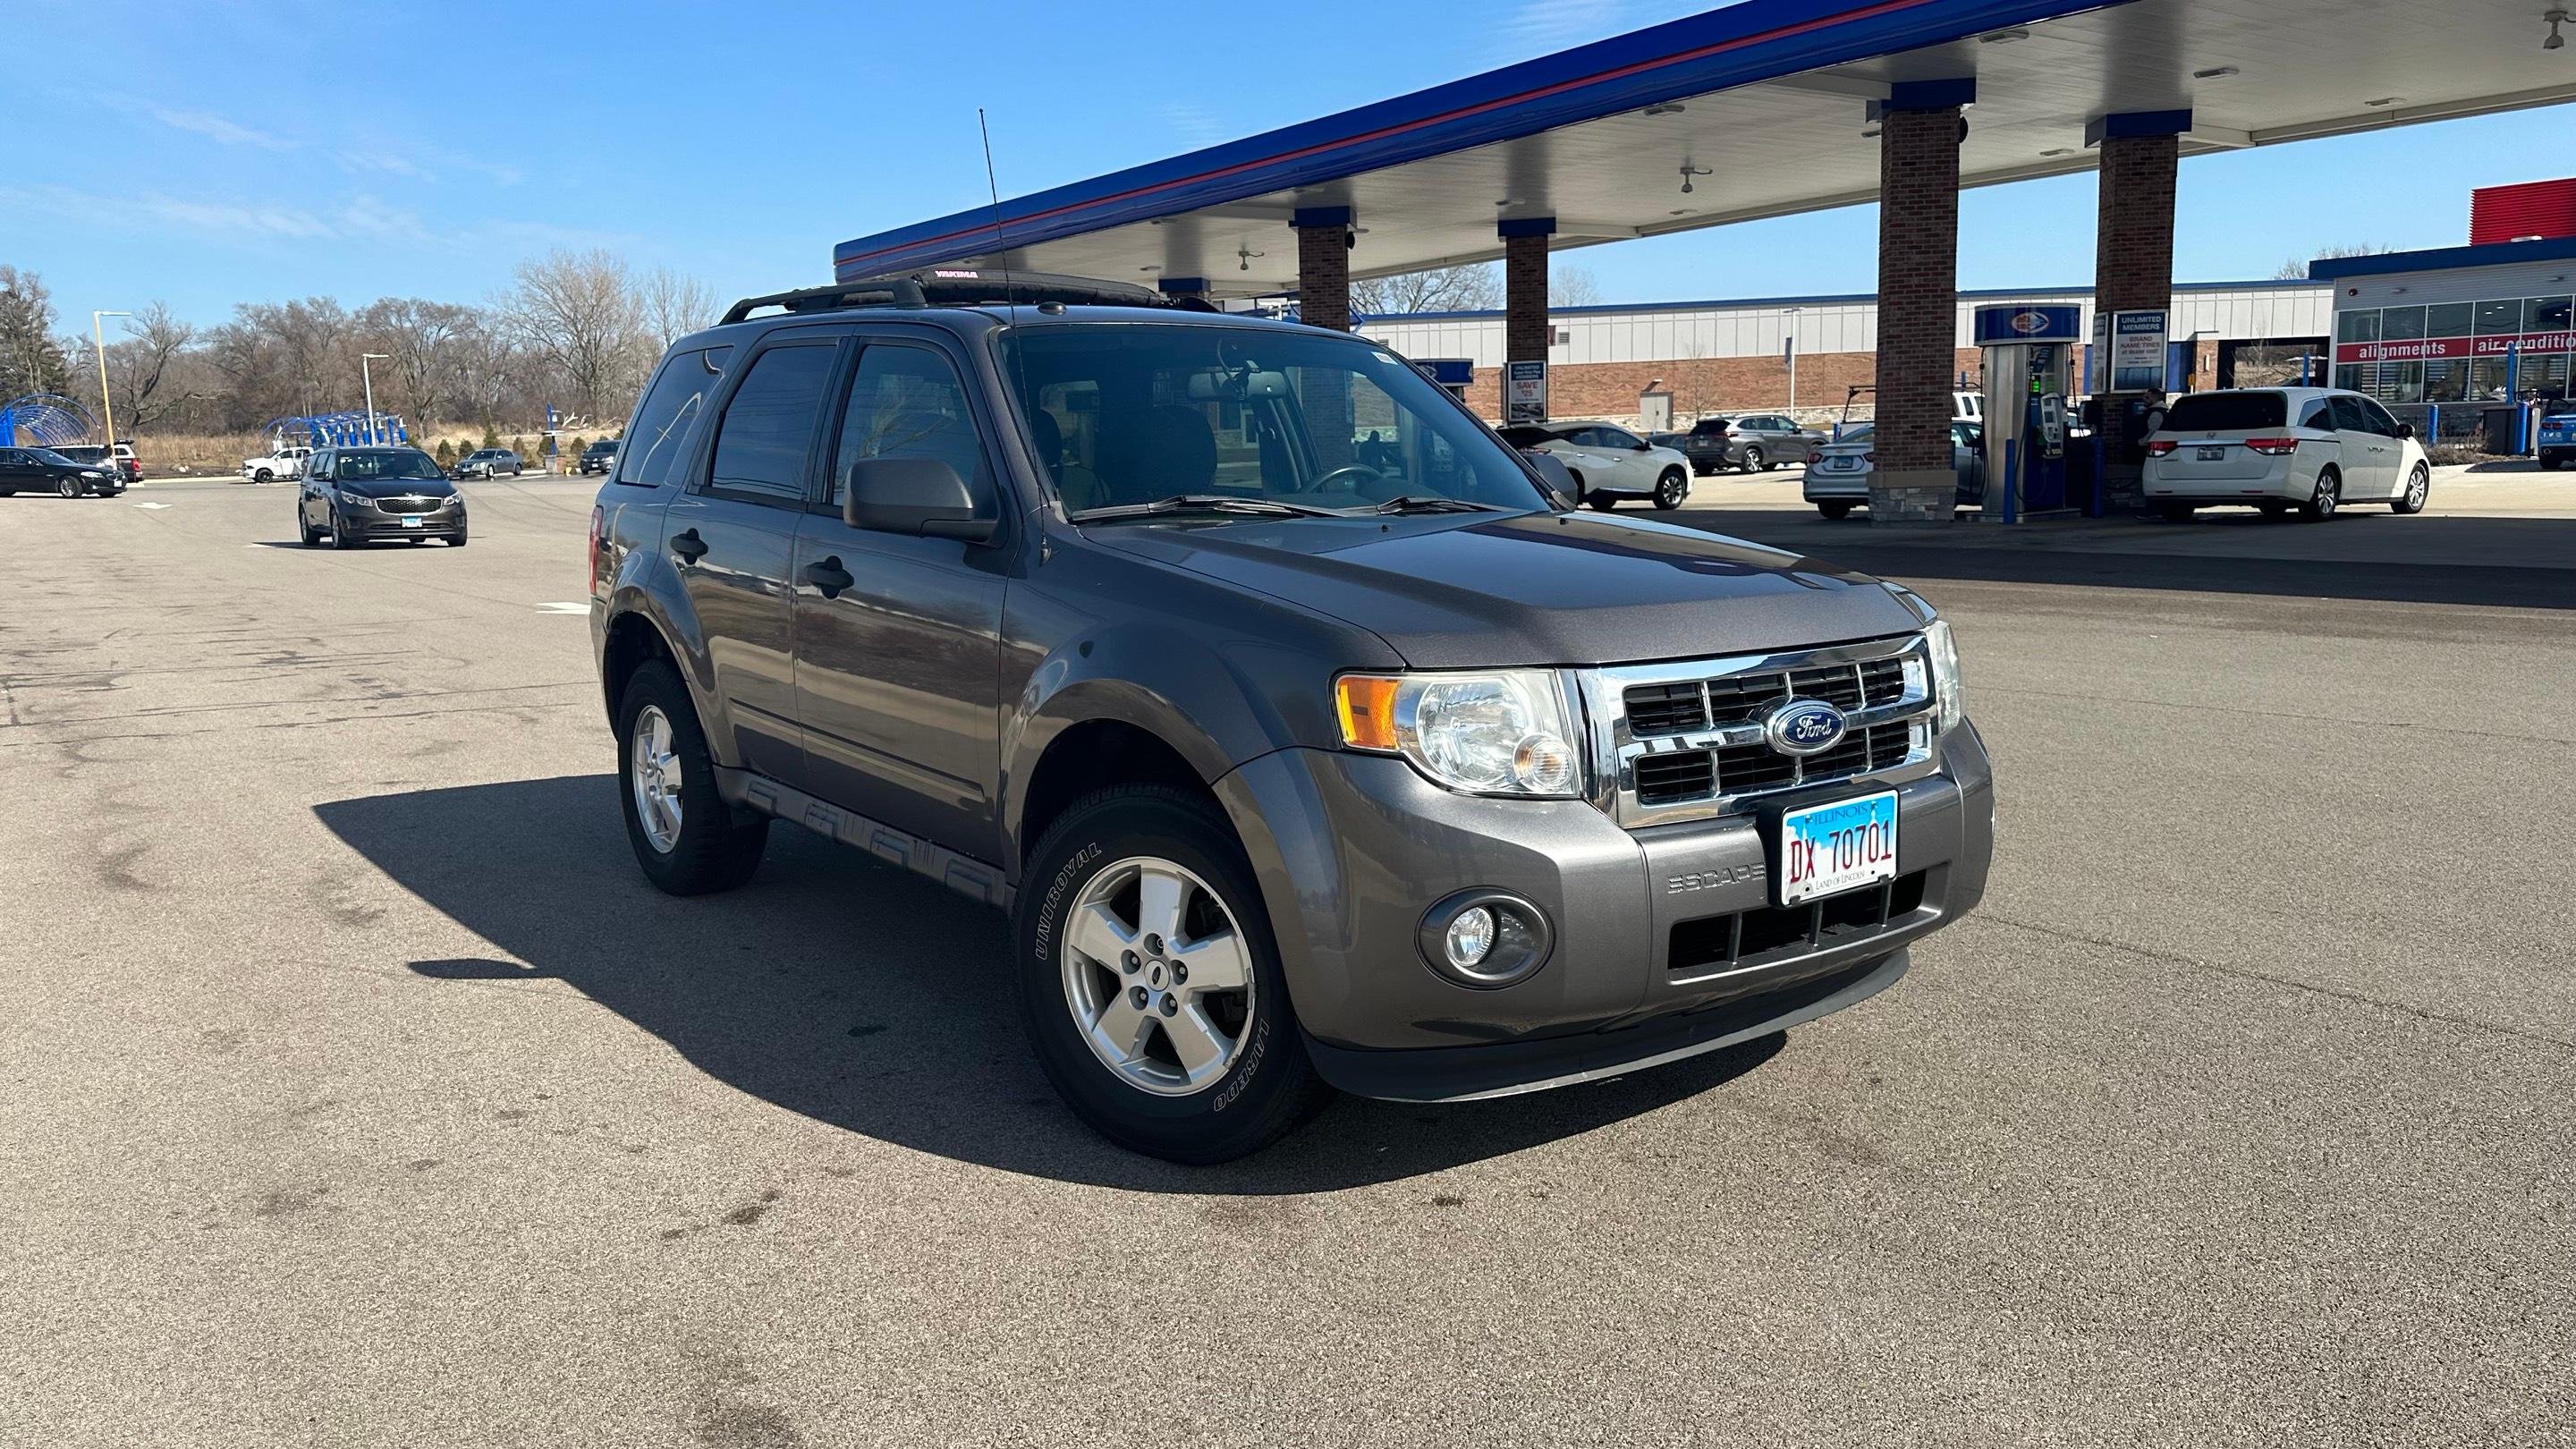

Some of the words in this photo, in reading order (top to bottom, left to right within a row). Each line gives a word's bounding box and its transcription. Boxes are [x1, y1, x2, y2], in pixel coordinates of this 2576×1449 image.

[935, 270, 979, 278] YAKIMA
[2121, 316, 2162, 324] UNLIMITED
[2123, 323, 2160, 331] MEMBERS
[2359, 342, 2446, 360] alignments
[2478, 339, 2500, 352] air
[1516, 381, 1538, 389] SAVE
[1796, 715, 1832, 739] Ford
[1814, 804, 1868, 826] ILLINOIS
[1791, 837, 1815, 883] DX
[1829, 819, 1892, 873] 70701
[1667, 861, 1766, 894] ESCAPE
[1816, 878, 1833, 890] LAND
[1841, 869, 1866, 884] LINCOLN
[1036, 842, 1102, 960] UNIROYAL
[1214, 1017, 1270, 1112] LAREDO
